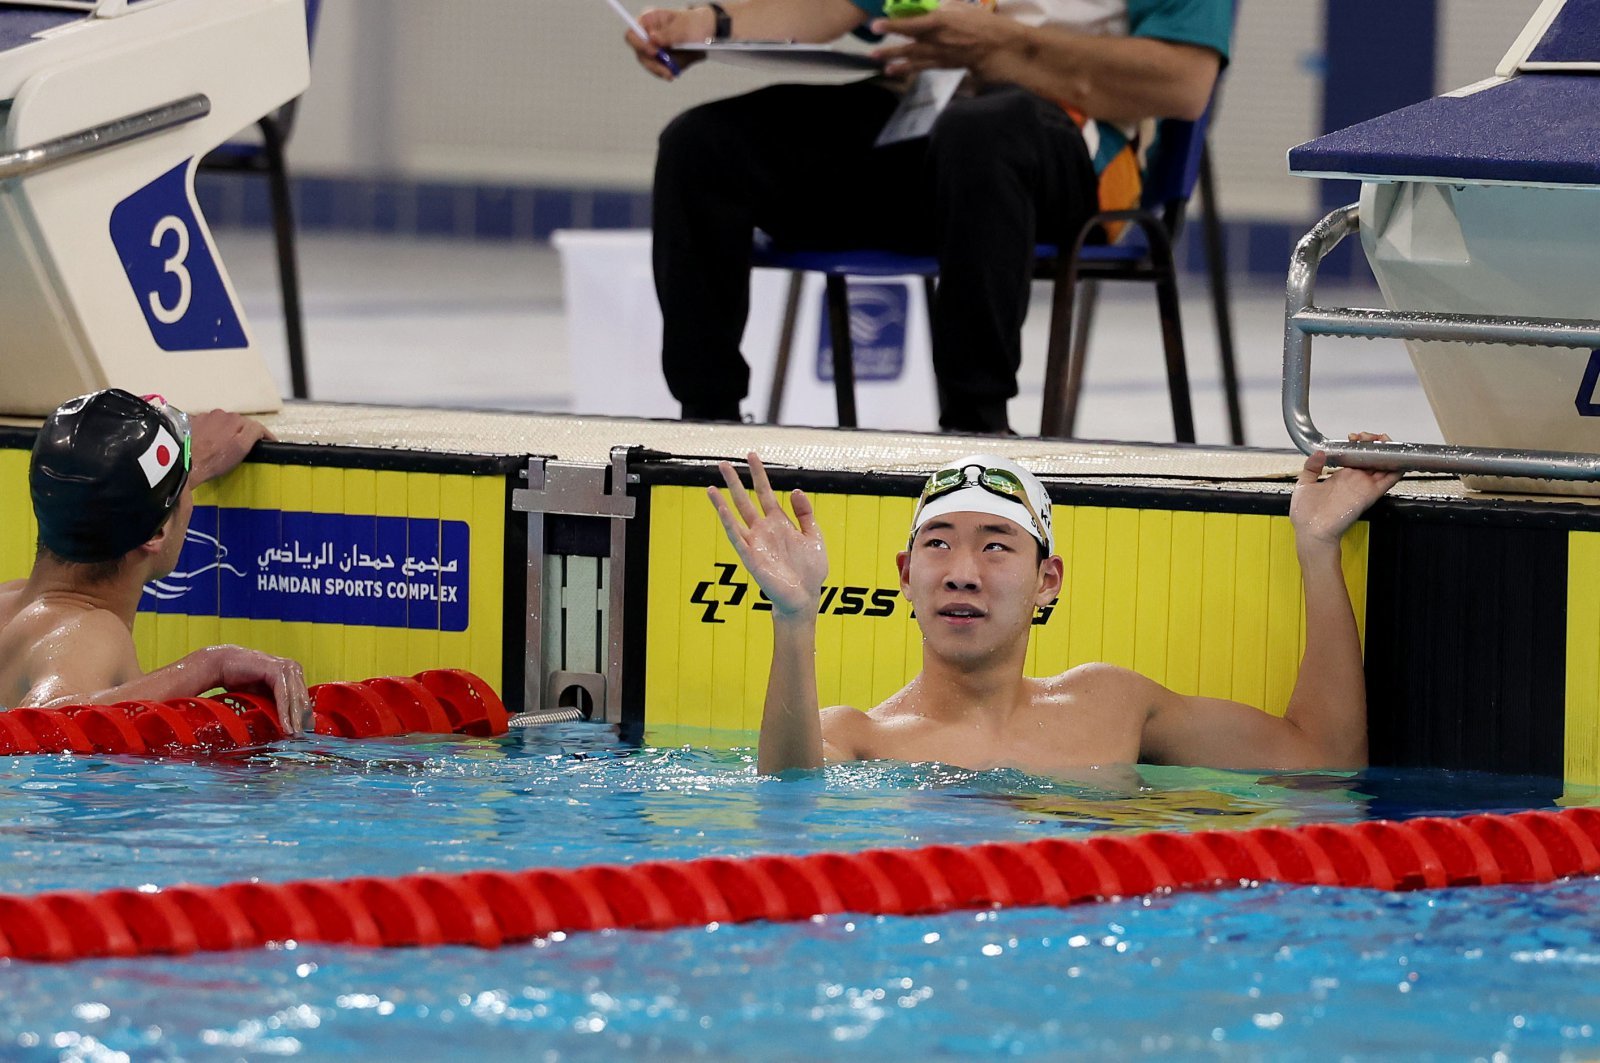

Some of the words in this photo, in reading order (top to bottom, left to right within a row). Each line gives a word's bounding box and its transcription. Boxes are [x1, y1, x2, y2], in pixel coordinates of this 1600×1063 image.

[149, 215, 192, 324] 3
[257, 540, 333, 571] الرياضي
[340, 544, 395, 573] حمدان
[401, 557, 457, 577] مجمع
[257, 574, 321, 595] HAMDAN
[325, 578, 383, 598] SPORTS
[386, 581, 457, 603] COMPLEX
[752, 586, 901, 617] ISS
